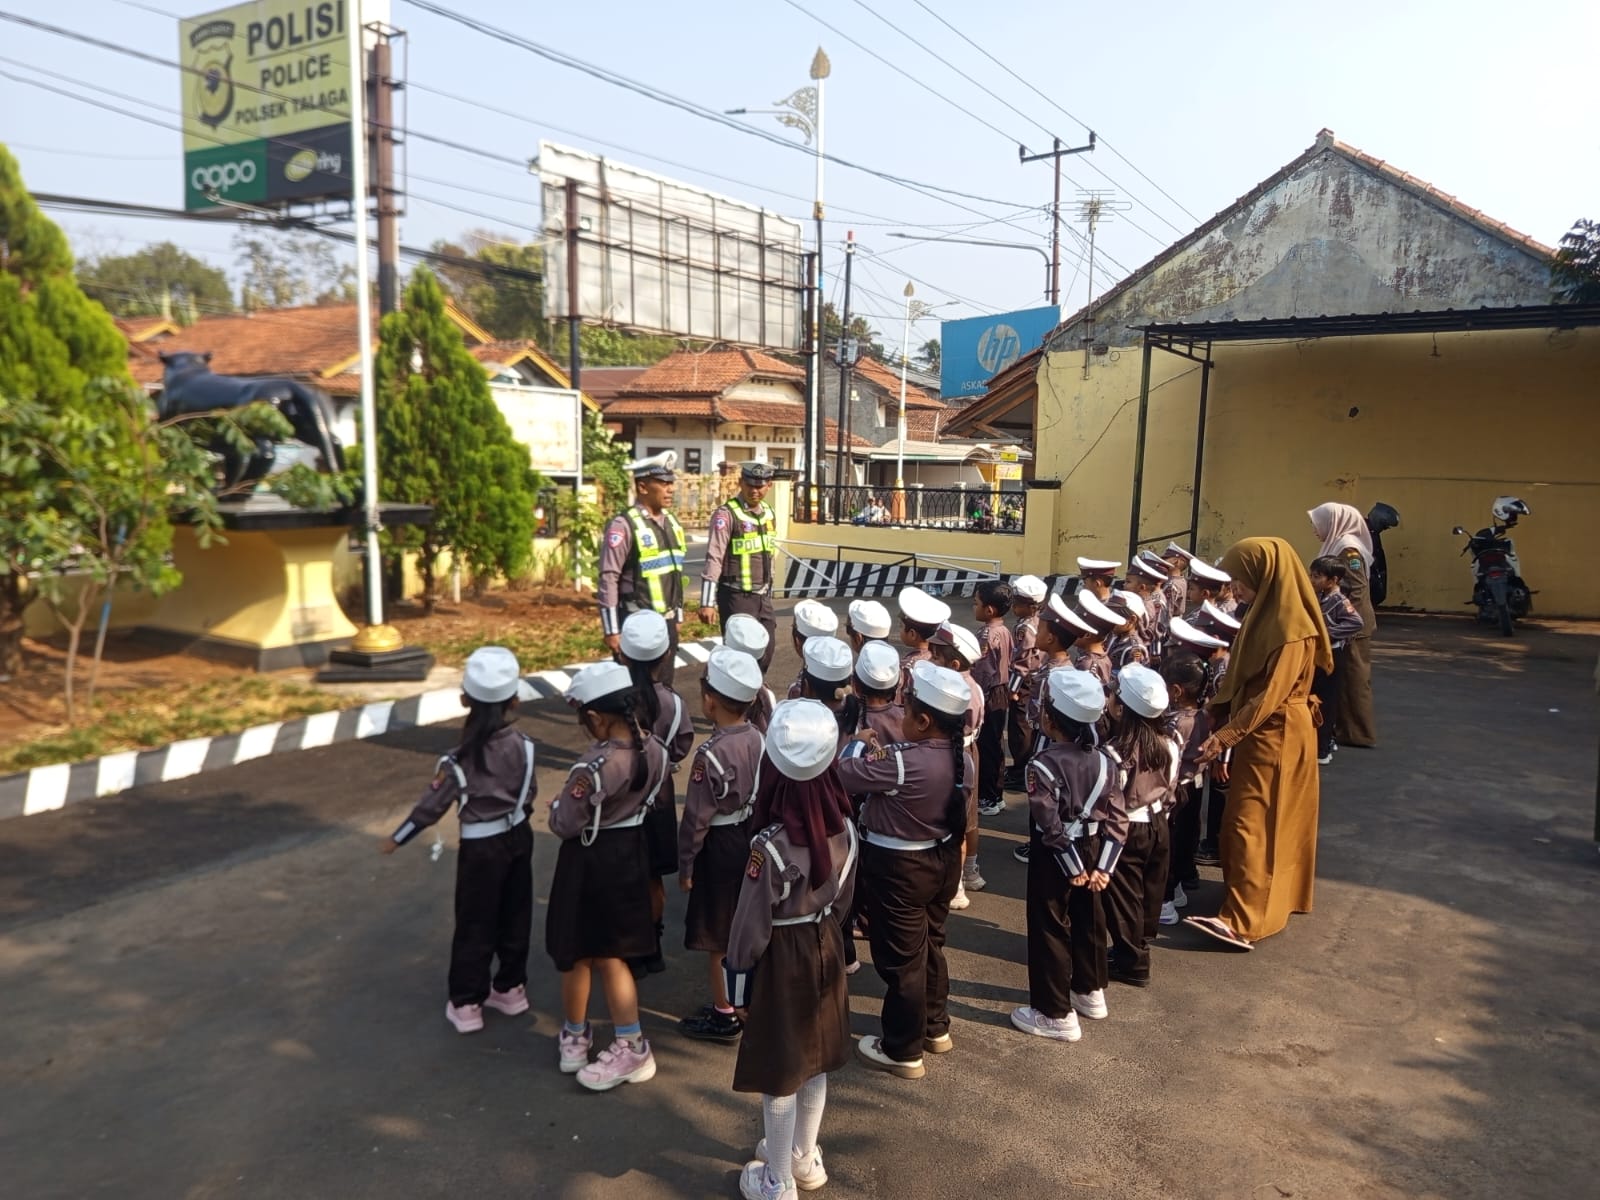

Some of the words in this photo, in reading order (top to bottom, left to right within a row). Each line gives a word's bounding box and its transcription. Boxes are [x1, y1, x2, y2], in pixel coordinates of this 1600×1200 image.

[247, 0, 345, 56] POLISI
[260, 53, 331, 89] POLICE
[235, 101, 288, 125] POLSEK
[292, 87, 348, 114] TALAGA
